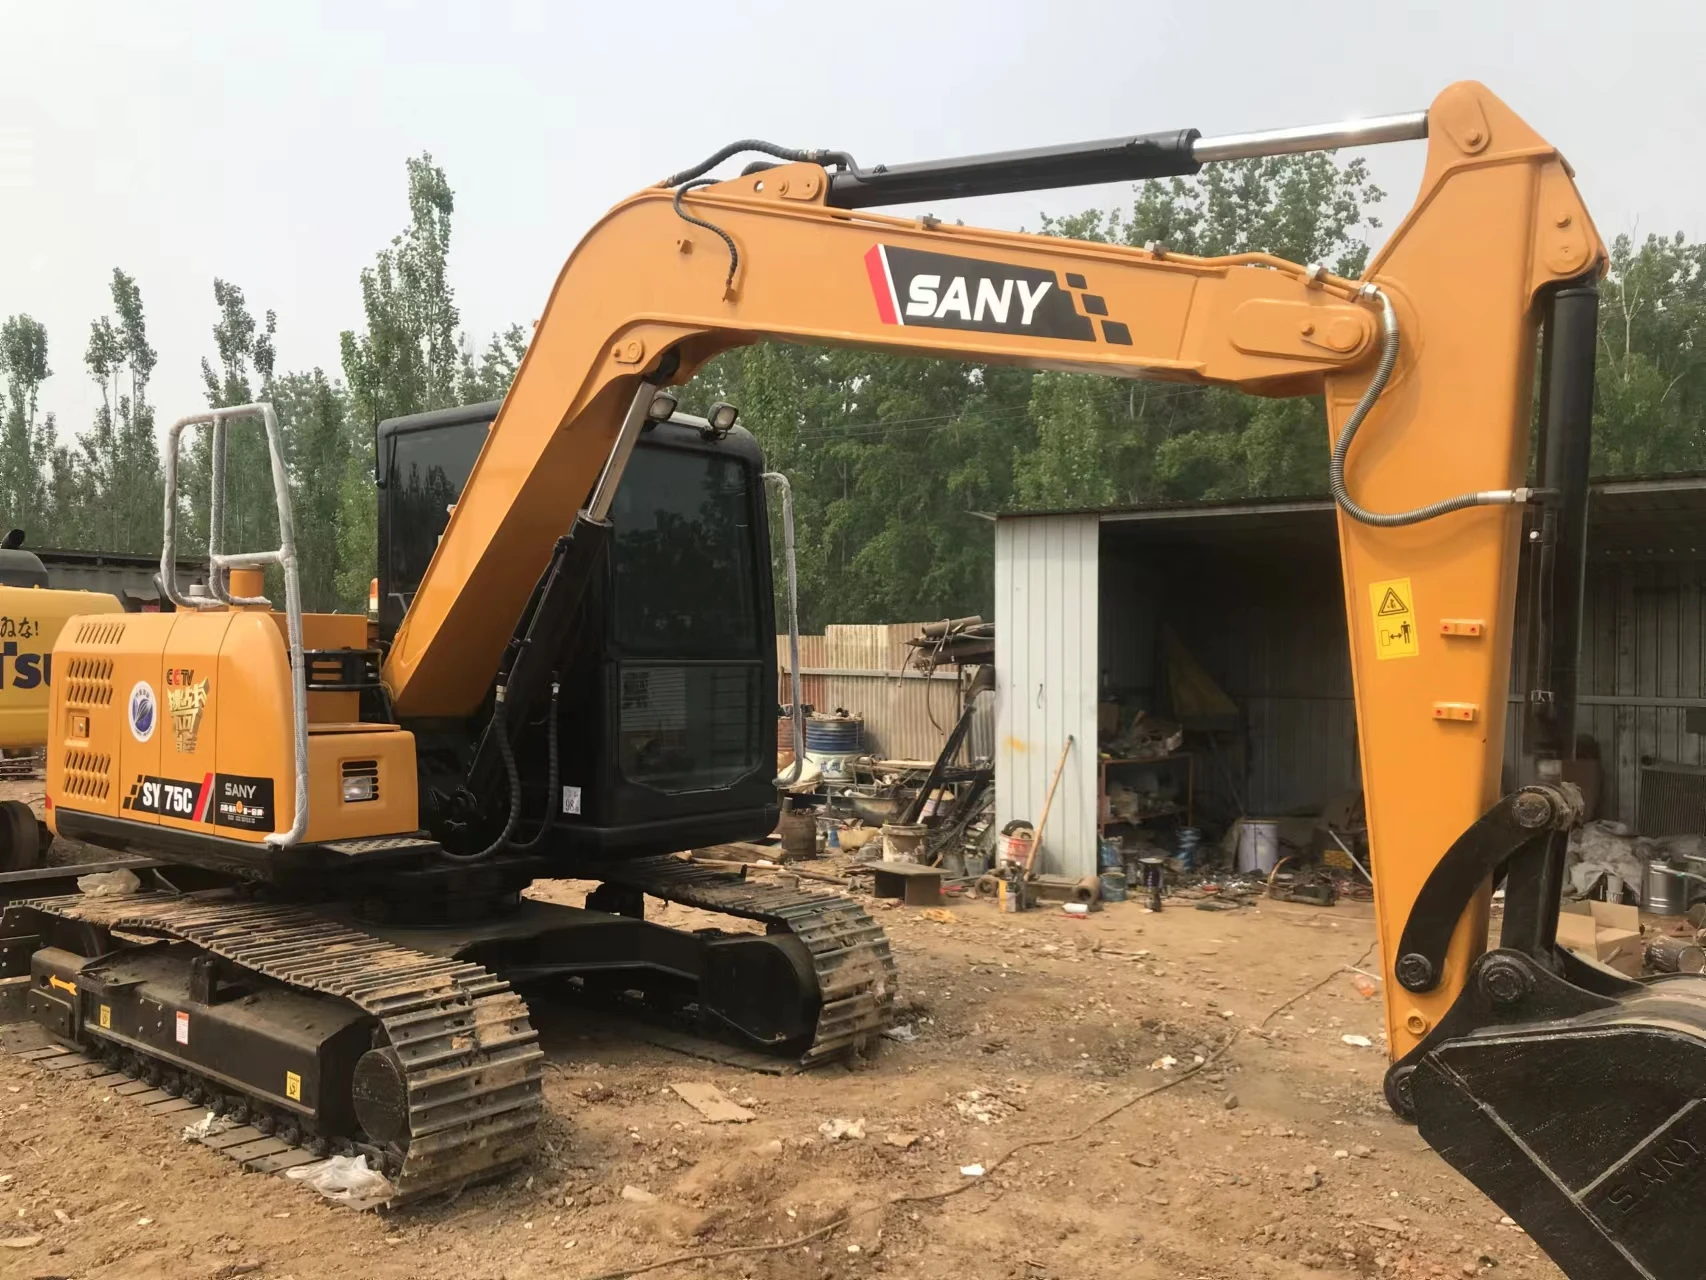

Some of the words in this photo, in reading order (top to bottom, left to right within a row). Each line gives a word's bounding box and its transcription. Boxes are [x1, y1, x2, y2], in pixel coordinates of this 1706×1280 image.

[906, 274, 1053, 325] SANY
[166, 669, 194, 686] CCTV
[142, 781, 161, 808] SY
[164, 785, 193, 813] 75C
[225, 783, 257, 799] SANY
[1605, 1138, 1700, 1214] SANY
